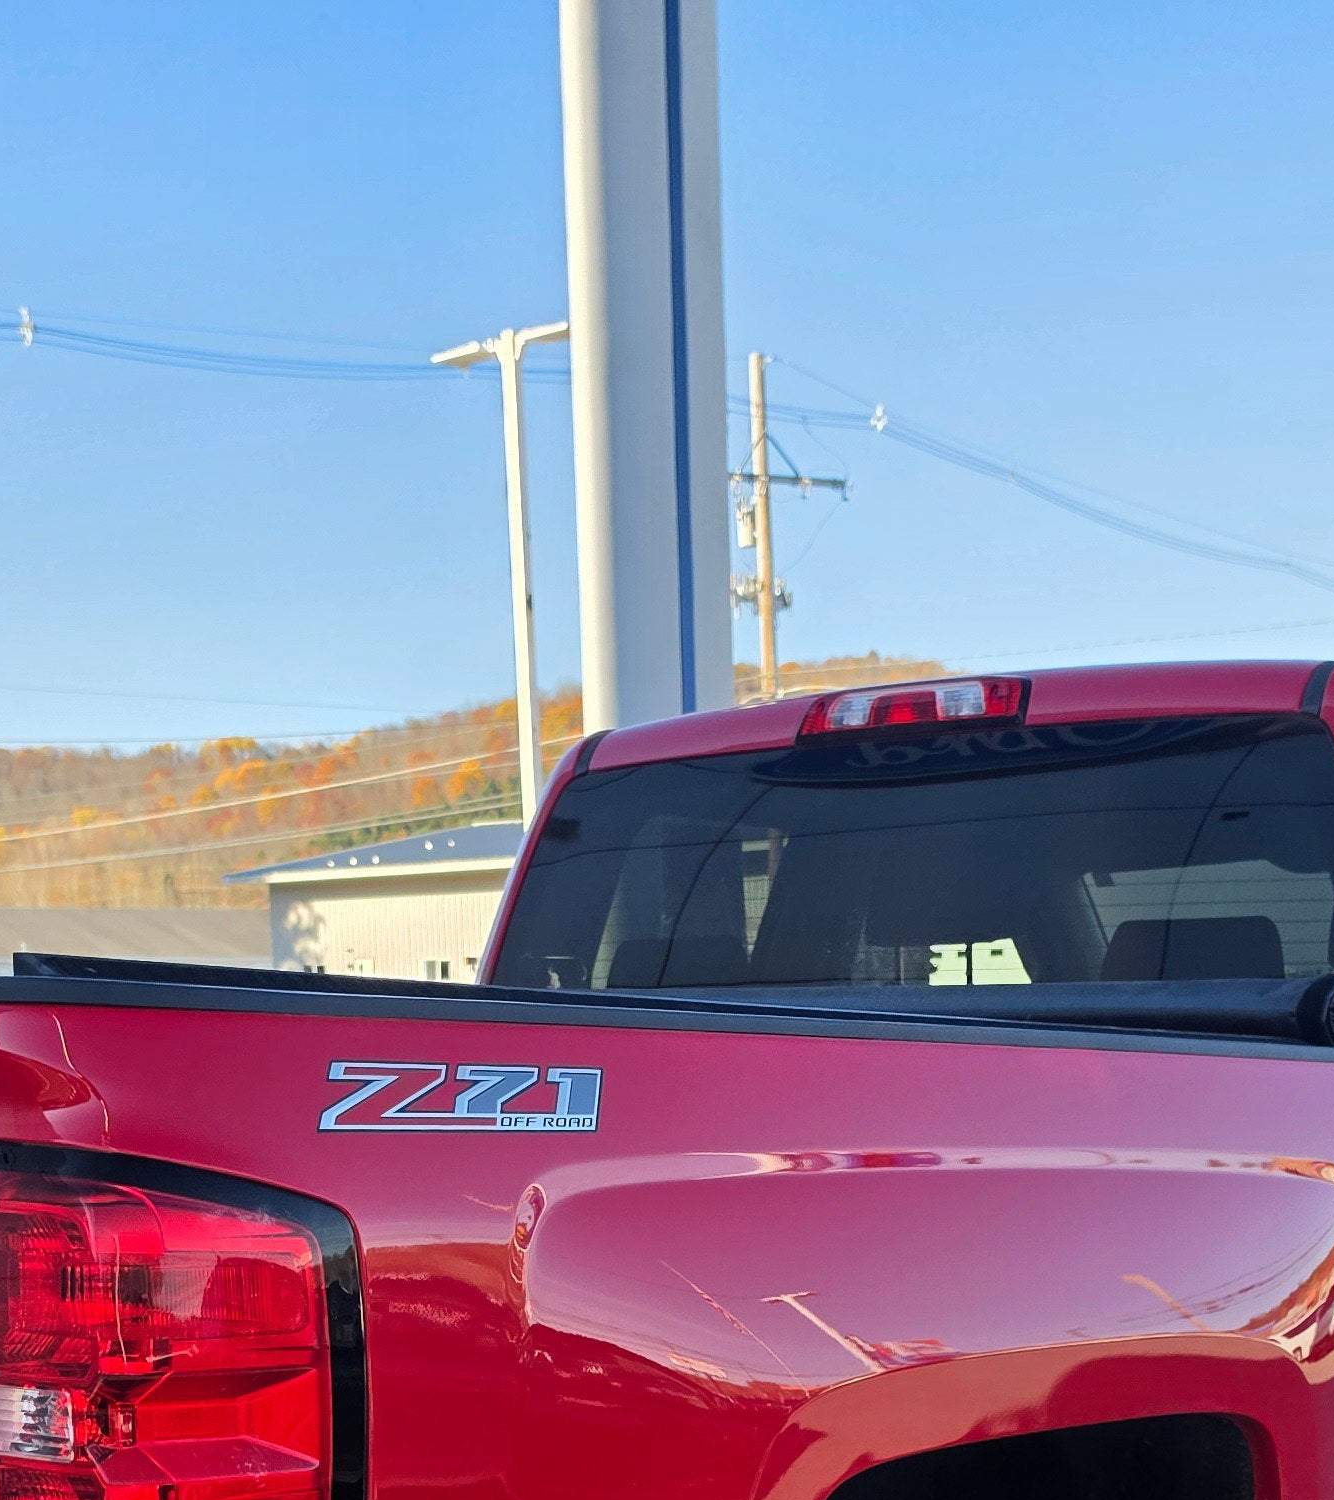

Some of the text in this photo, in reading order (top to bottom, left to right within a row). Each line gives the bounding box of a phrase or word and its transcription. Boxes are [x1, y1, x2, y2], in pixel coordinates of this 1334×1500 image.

[318, 1060, 603, 1132] Z71
[500, 1116, 593, 1128] OFF ROAD
